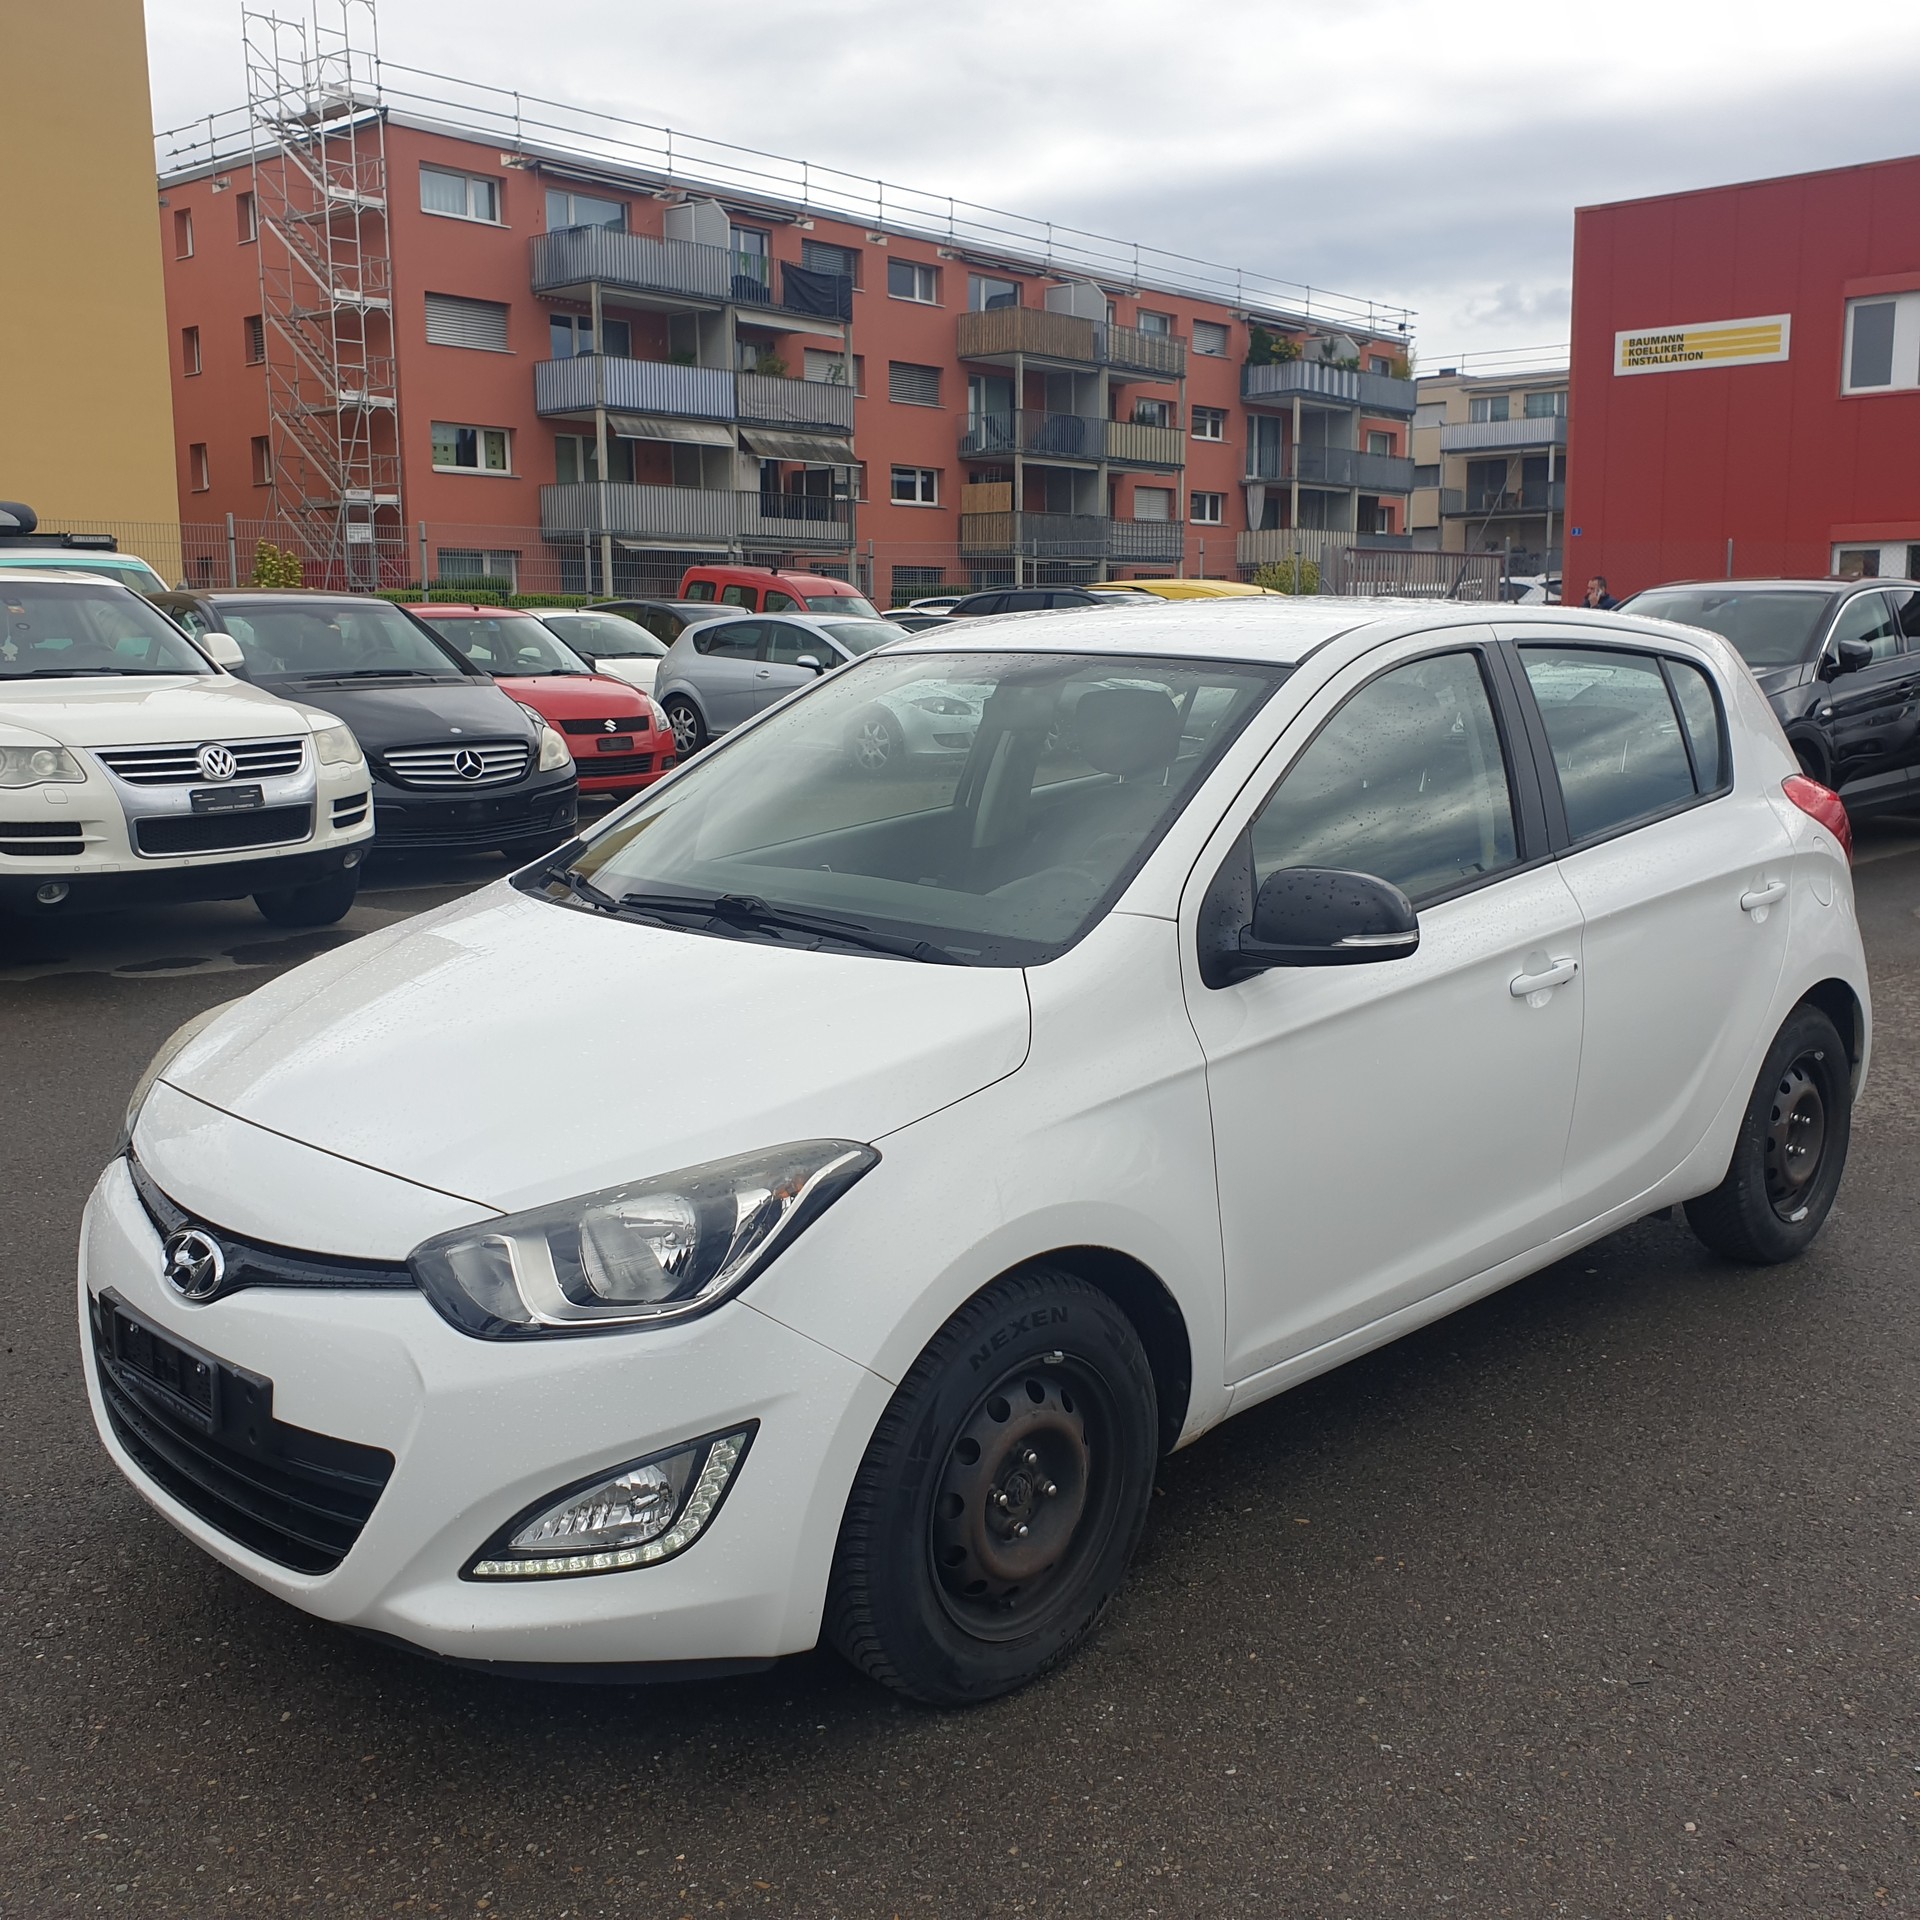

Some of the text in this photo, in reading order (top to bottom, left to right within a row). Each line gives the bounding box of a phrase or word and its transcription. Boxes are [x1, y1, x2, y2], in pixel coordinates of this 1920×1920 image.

[1629, 333, 1684, 347] BAUMANN
[1628, 343, 1685, 357] KOELLIKER
[1628, 351, 1704, 367] INSTALLATION
[968, 1306, 1068, 1372] NEXEN
